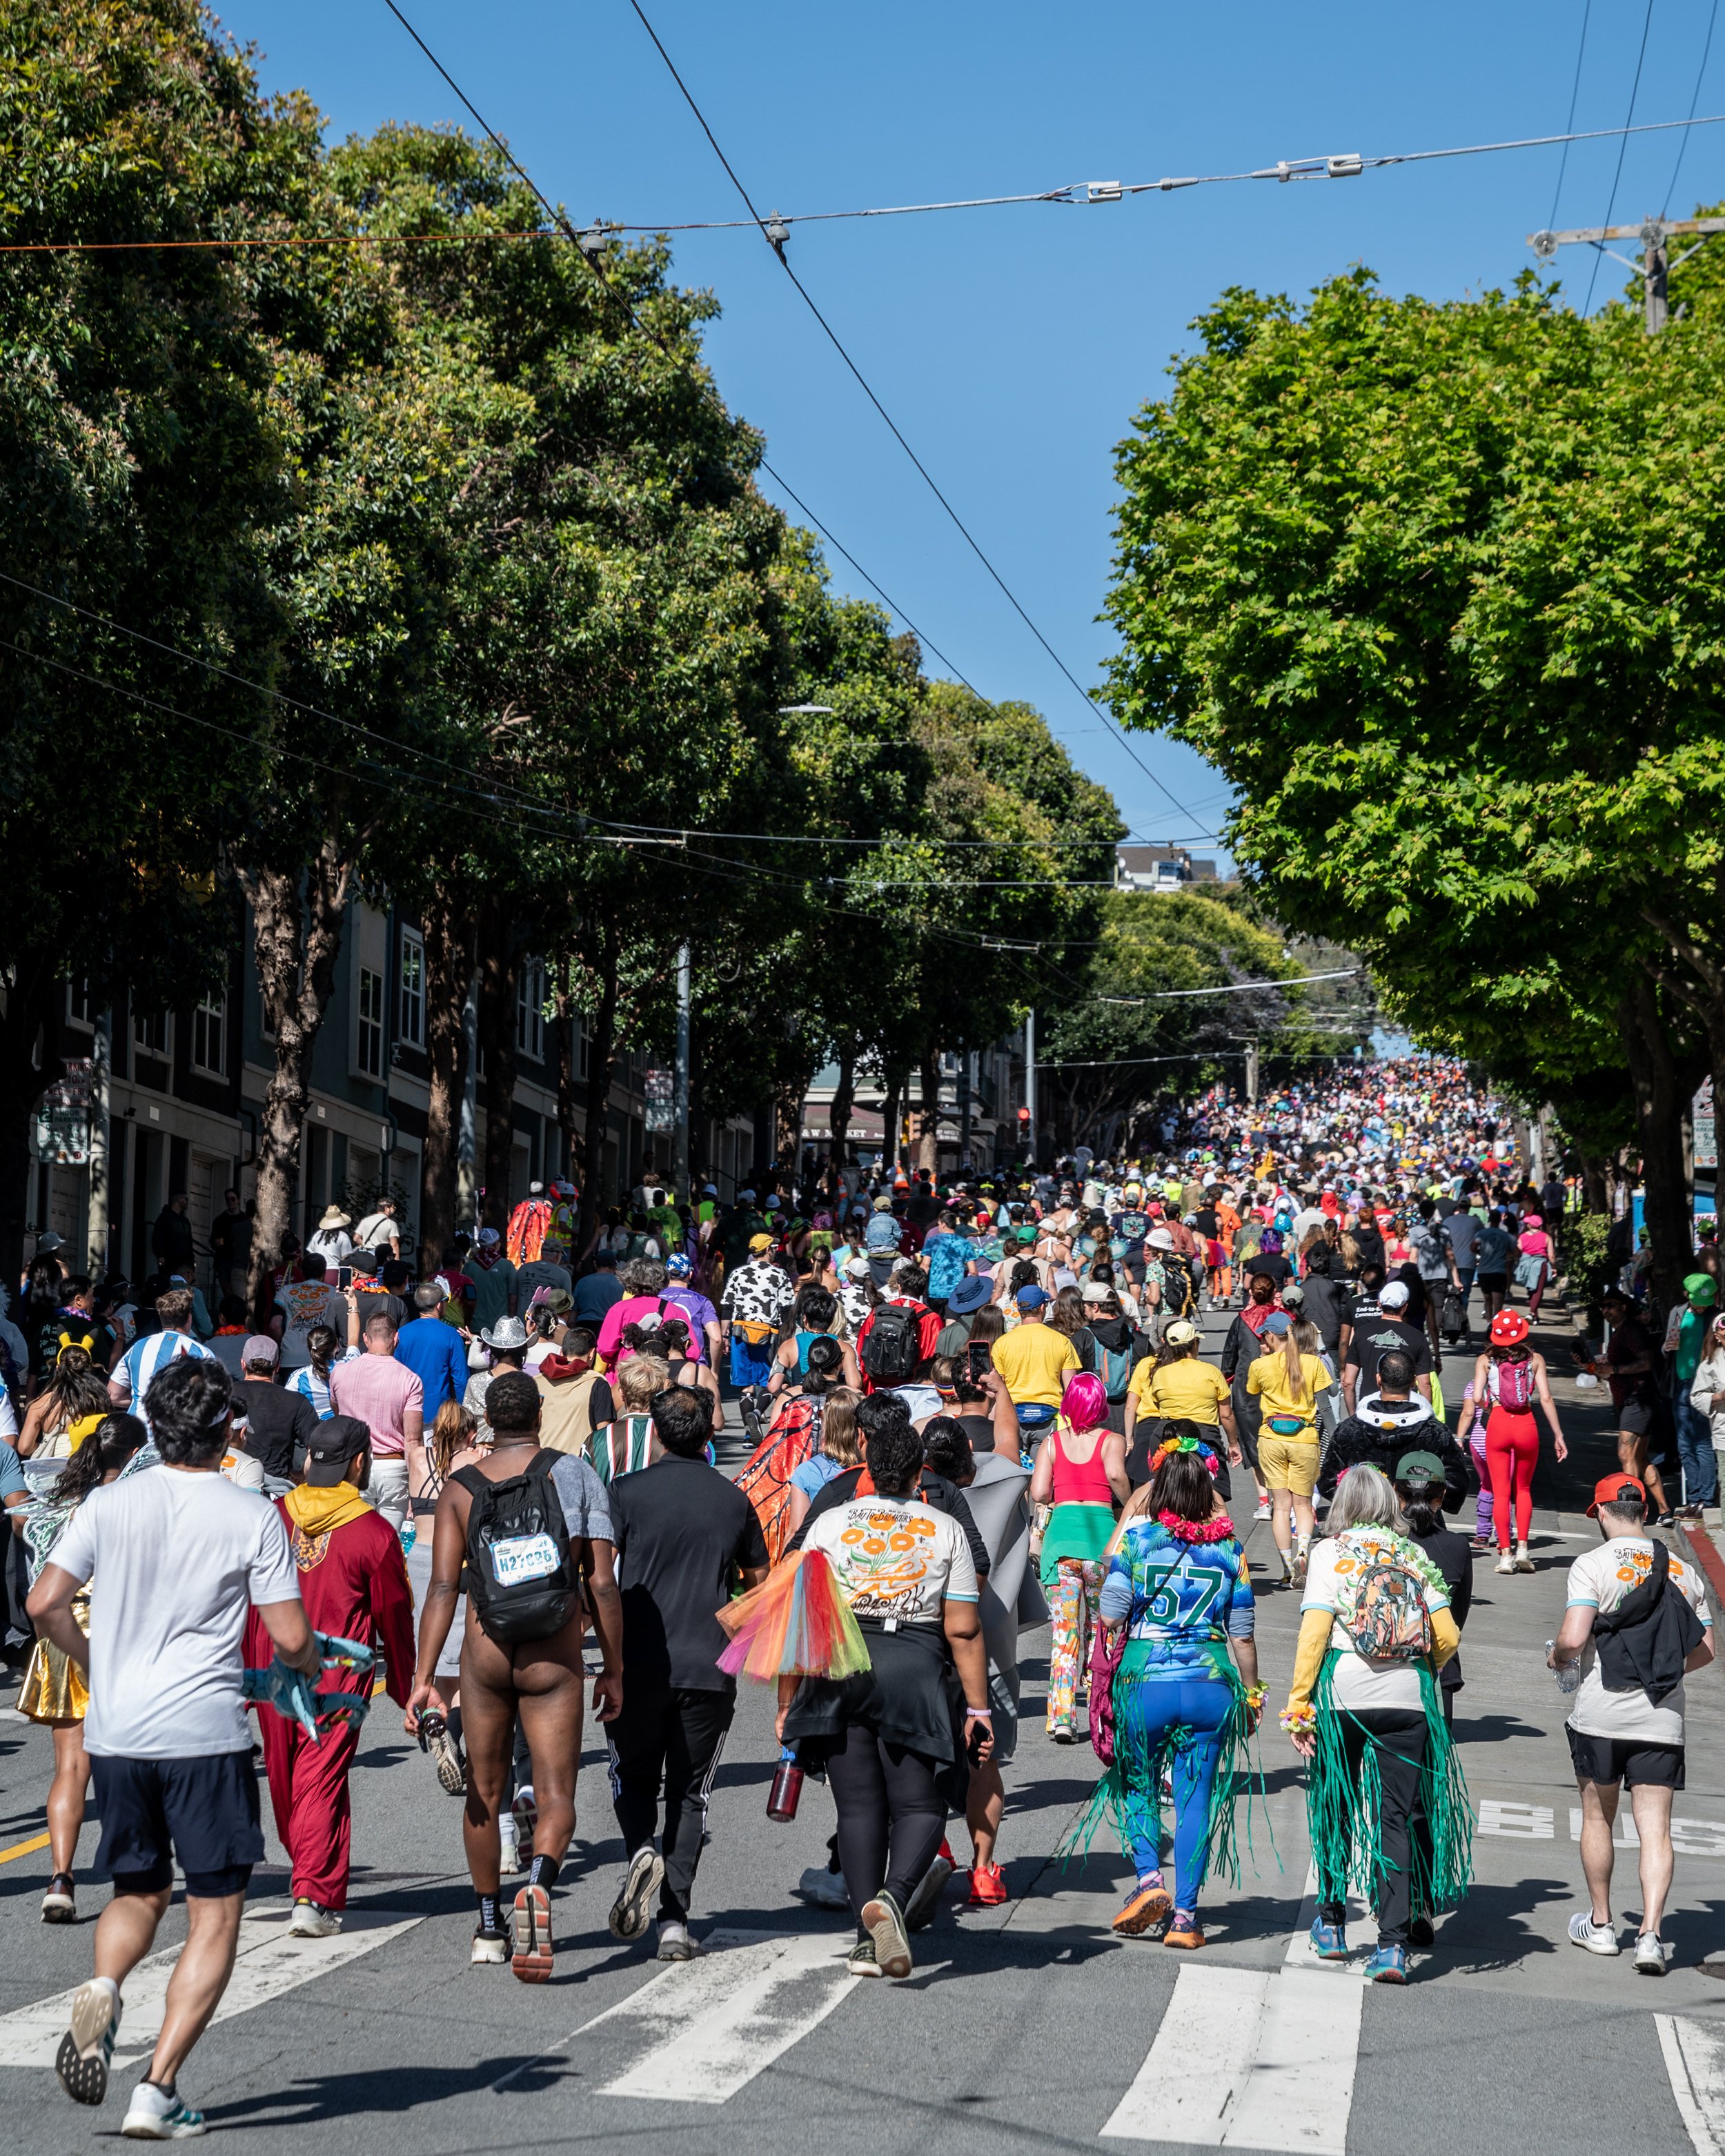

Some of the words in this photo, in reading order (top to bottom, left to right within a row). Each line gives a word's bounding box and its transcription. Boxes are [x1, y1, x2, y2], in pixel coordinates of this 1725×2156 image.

[66, 1062, 89, 1071] ARKING
[41, 1108, 51, 1121] 2
[825, 1129, 867, 1137] MKET
[1144, 1563, 1225, 1628] 57
[1477, 1799, 1725, 1857] BUS
